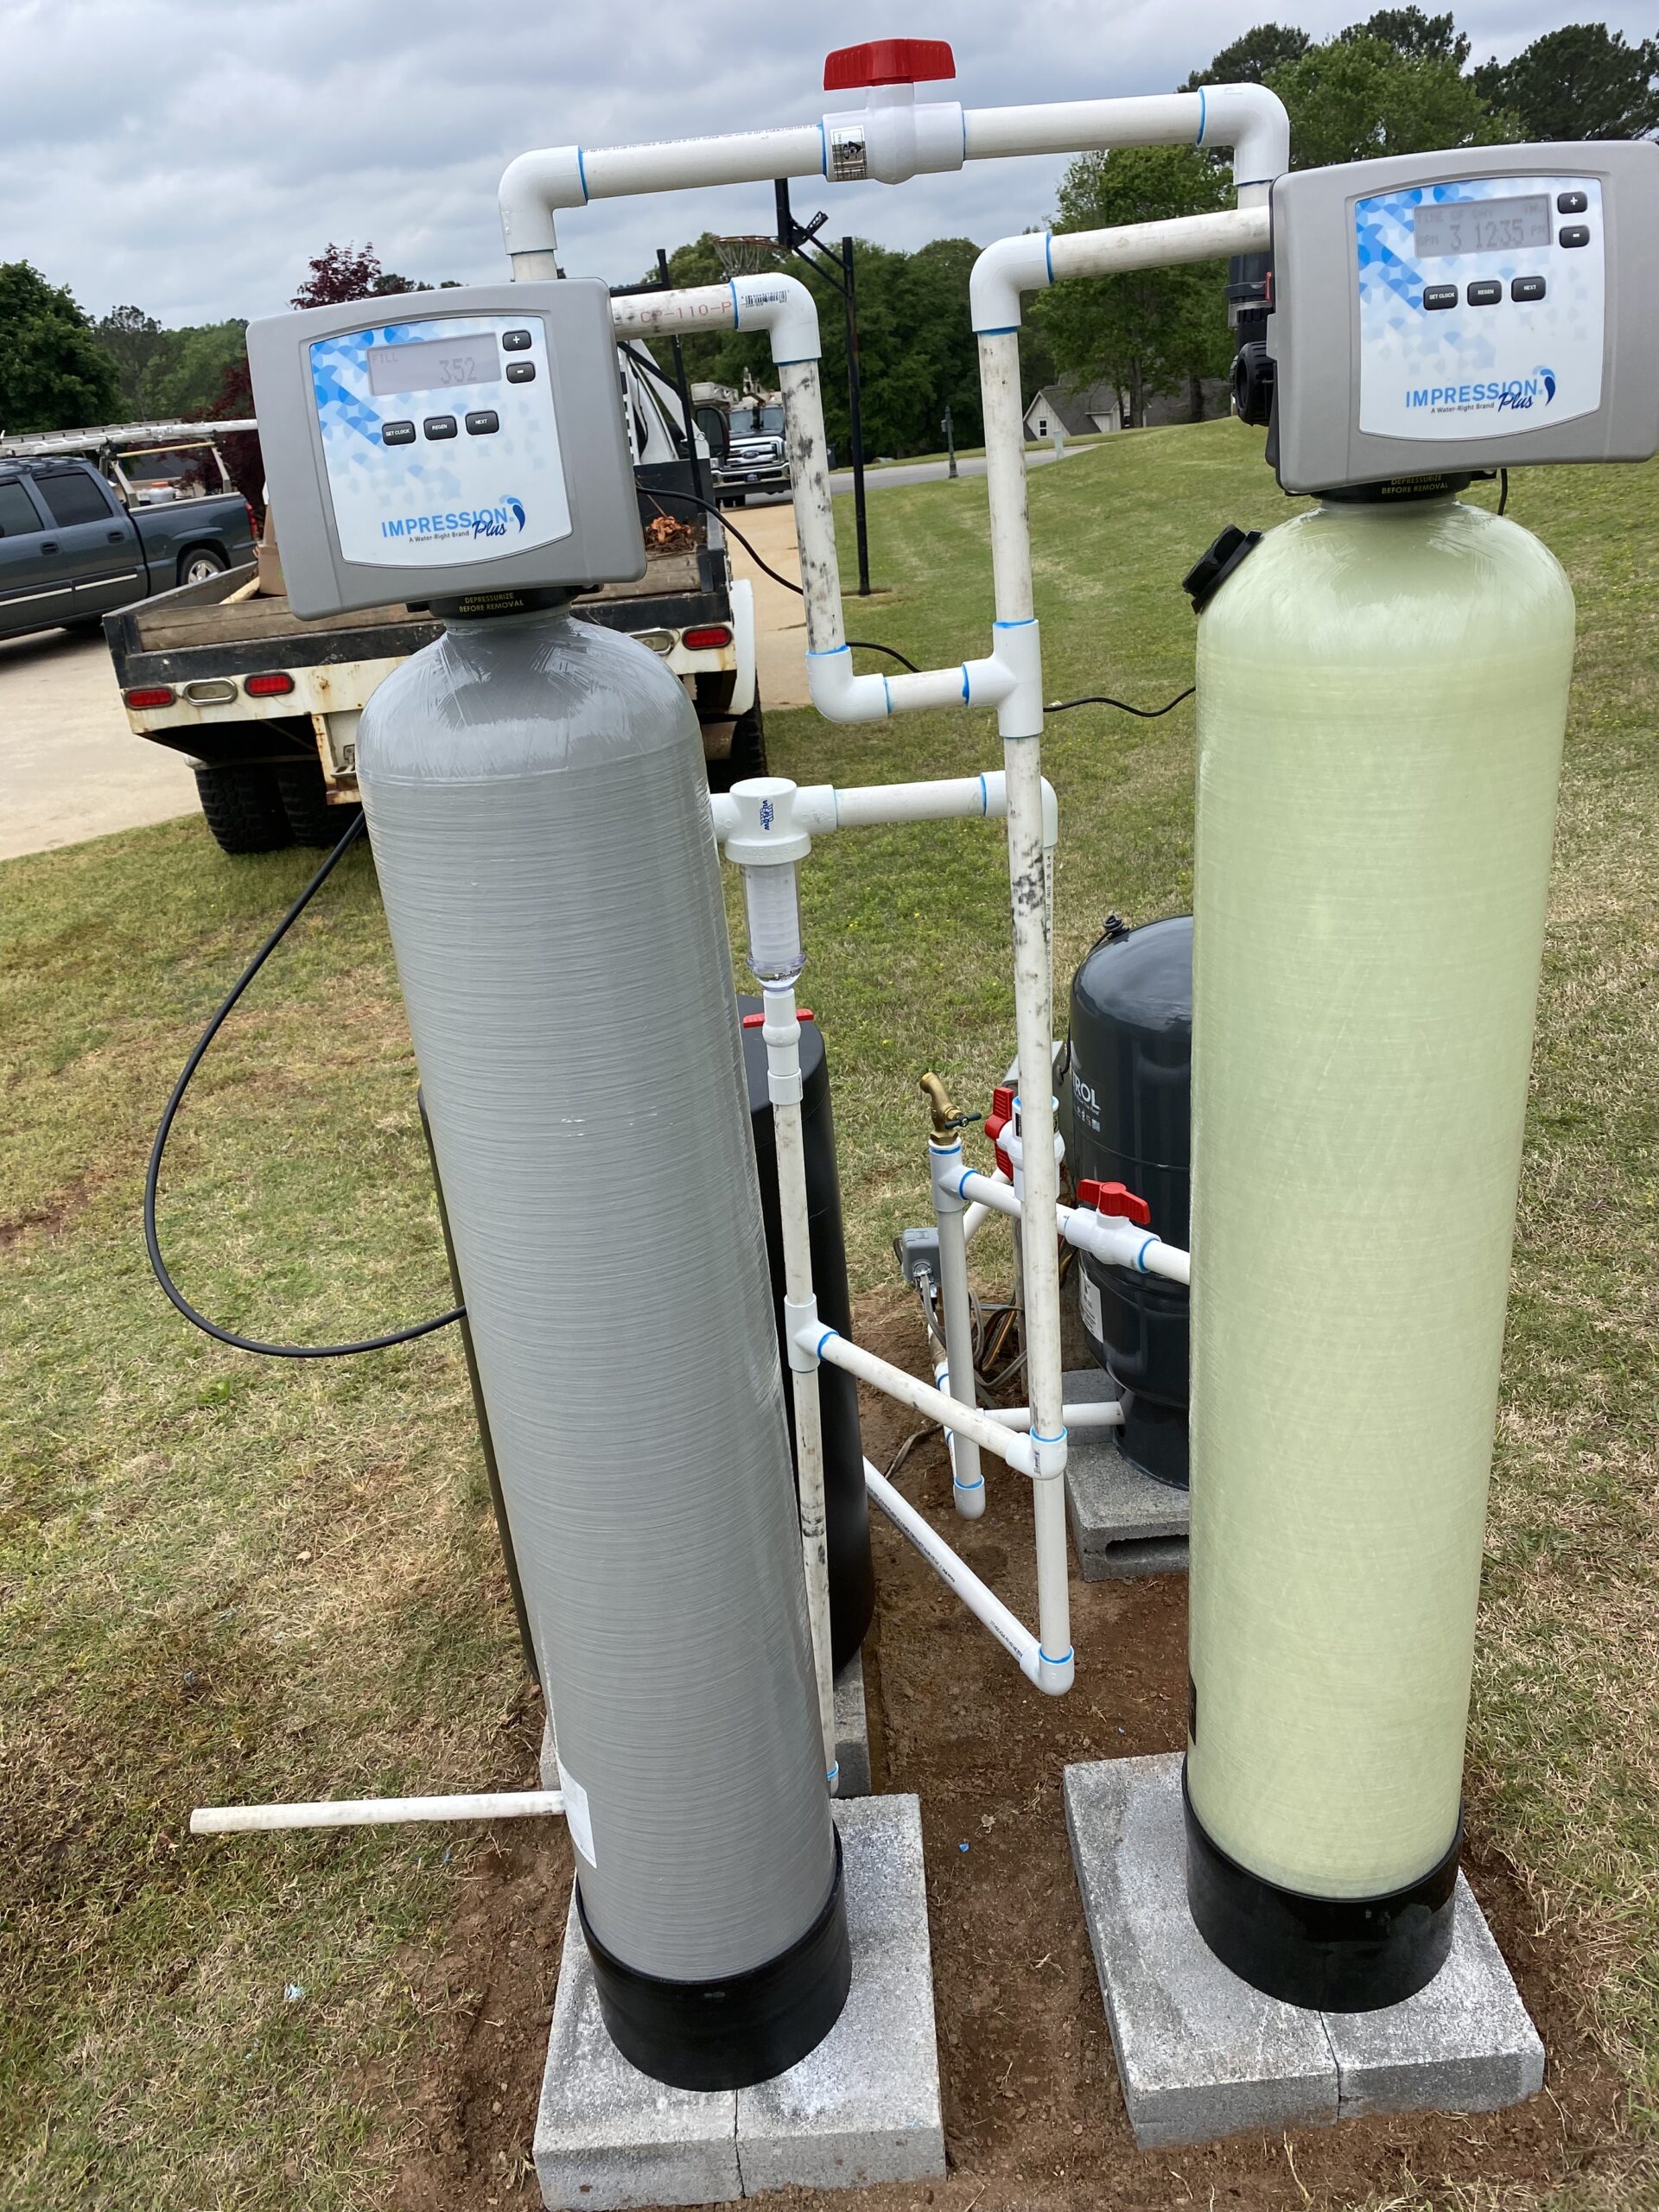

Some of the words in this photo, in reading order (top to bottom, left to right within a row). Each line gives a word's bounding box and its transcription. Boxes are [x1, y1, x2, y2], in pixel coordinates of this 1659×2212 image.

[1449, 225, 1462, 251] 3
[1405, 378, 1538, 408] IMPRESSION
[1497, 391, 1535, 412] Plus
[1437, 404, 1474, 413] Water-Right
[1475, 402, 1495, 410] Brand
[1413, 481, 1449, 492] REMOVAL
[381, 507, 508, 538] IMPRESSION
[471, 519, 507, 540] Plus
[415, 532, 451, 543] Water-Right
[451, 530, 470, 538] Brand
[459, 604, 485, 613] BEFORE
[486, 599, 524, 610] REMOVAL
[464, 592, 515, 604] DEPRESSURIZE
